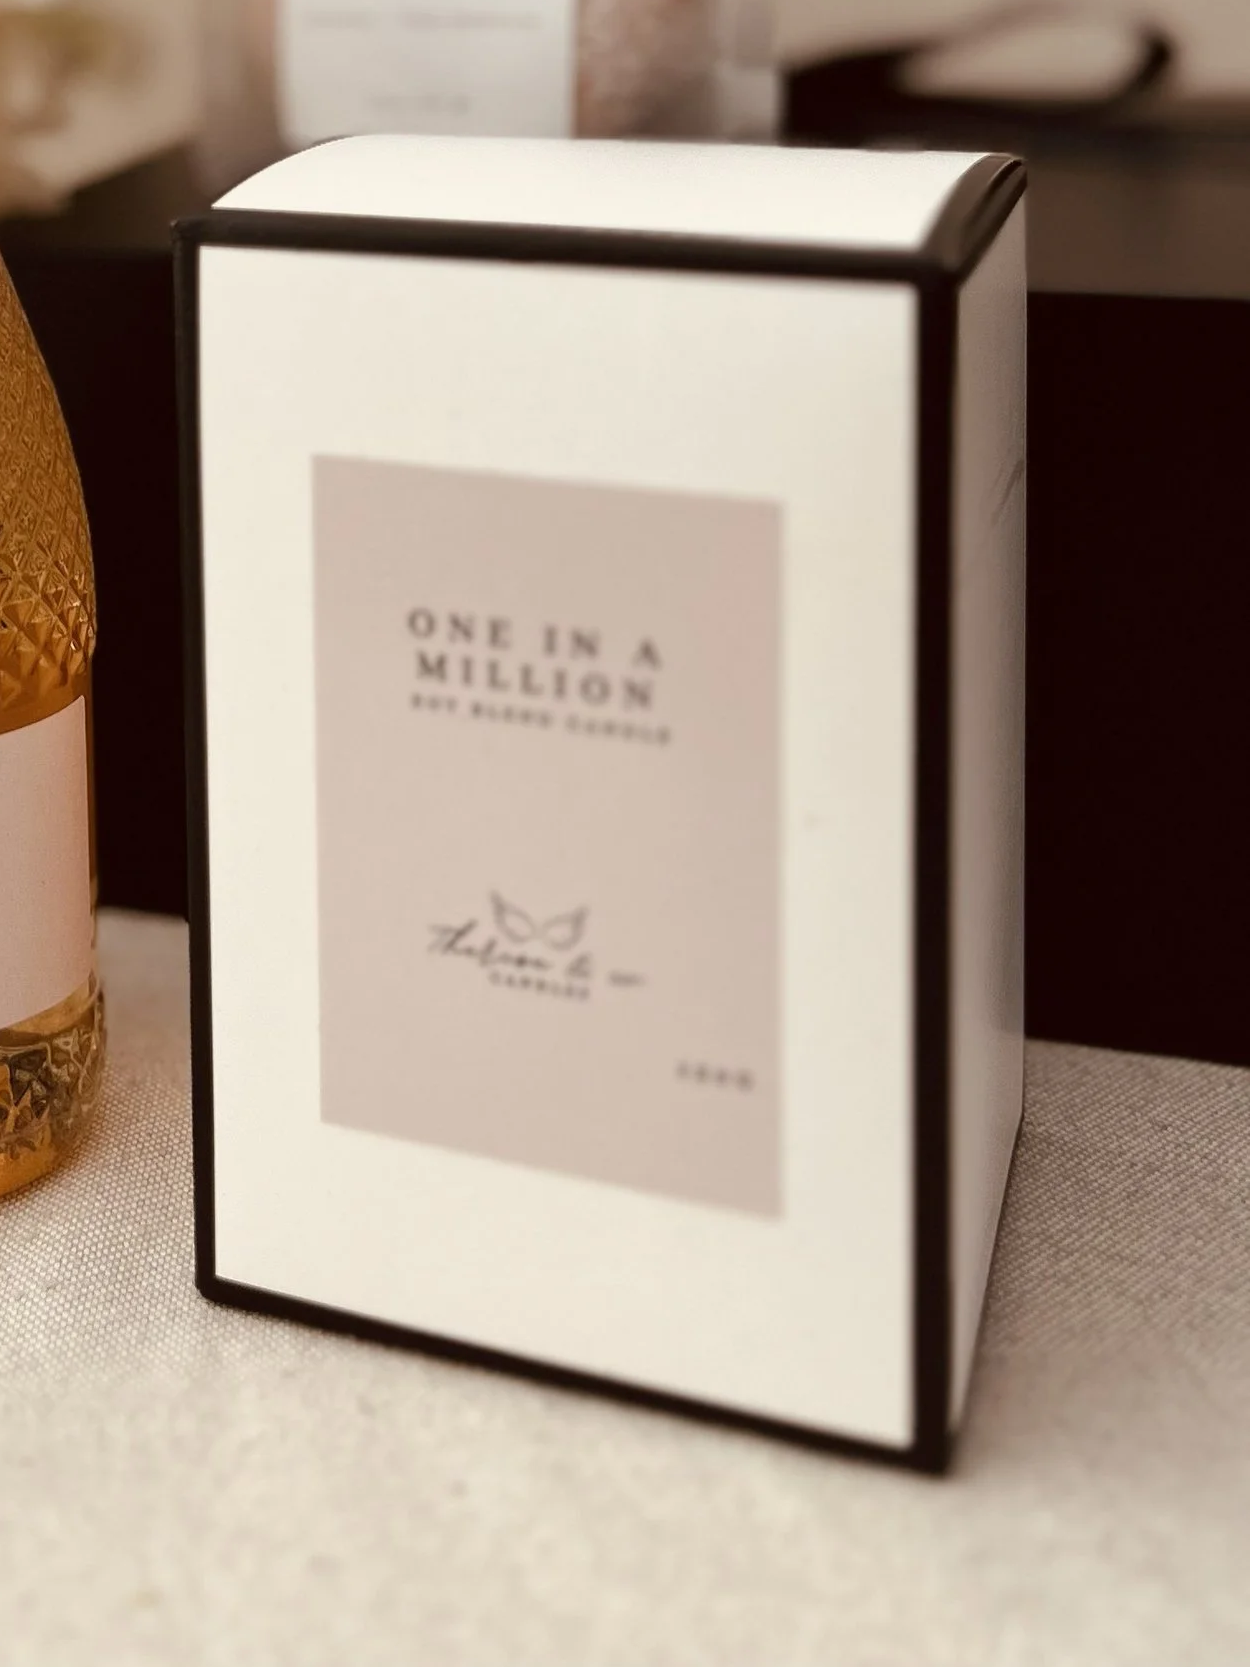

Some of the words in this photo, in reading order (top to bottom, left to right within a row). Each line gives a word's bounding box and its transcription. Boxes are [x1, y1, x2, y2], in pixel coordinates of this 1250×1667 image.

[406, 606, 514, 652] ONE
[540, 621, 603, 661] IN
[630, 635, 664, 672] A
[415, 649, 655, 710] MILLION
